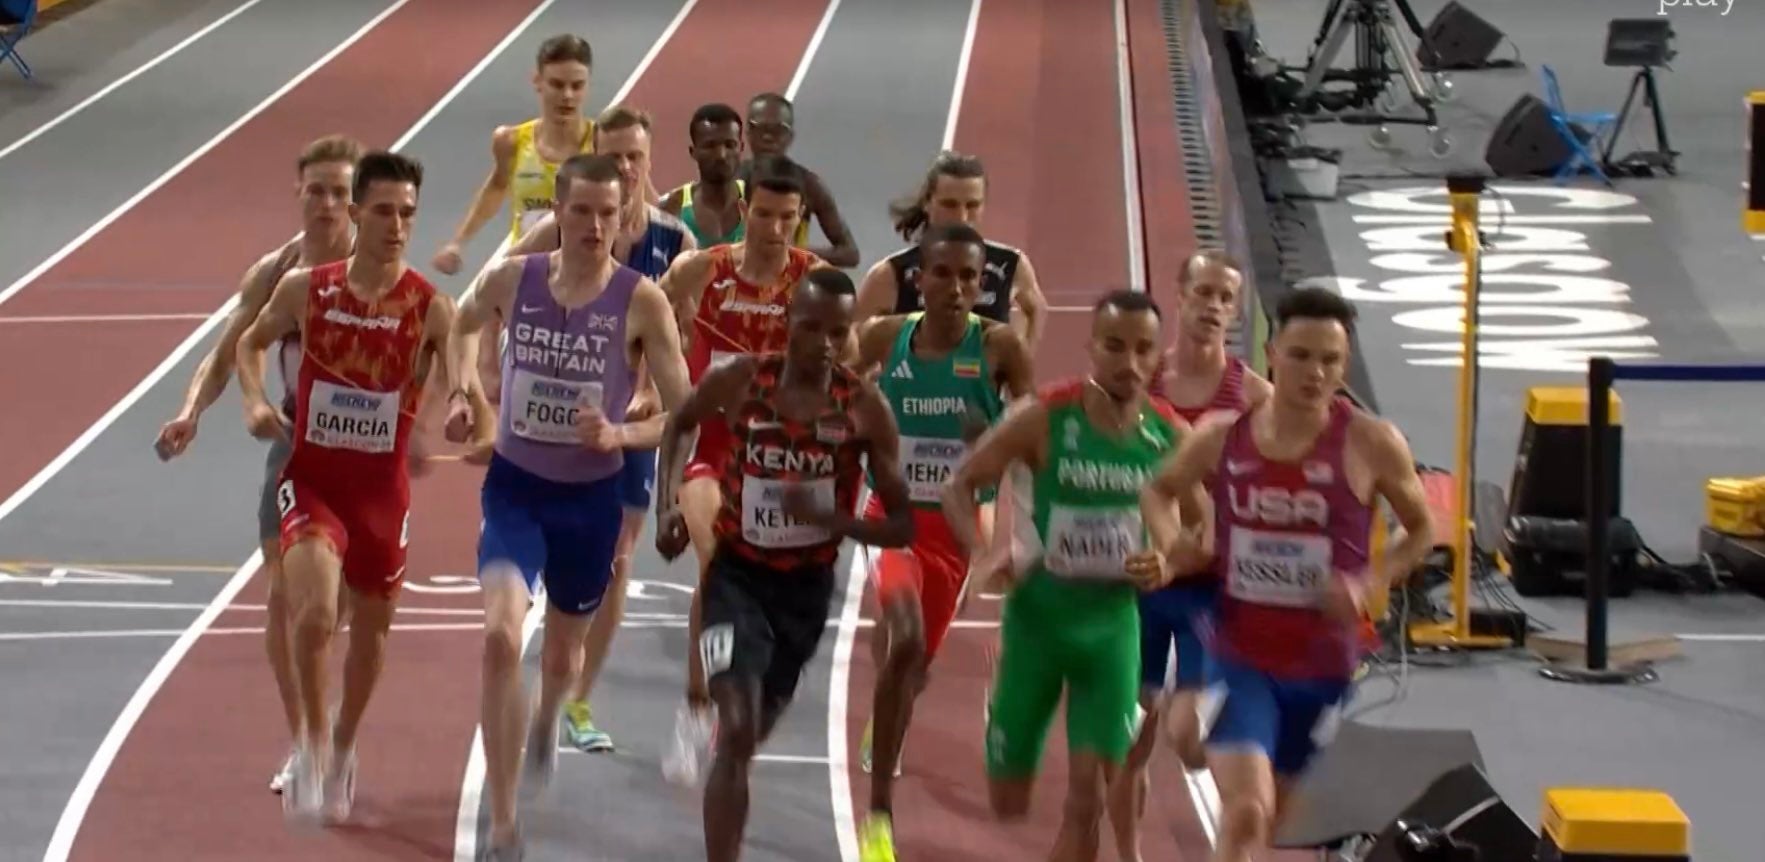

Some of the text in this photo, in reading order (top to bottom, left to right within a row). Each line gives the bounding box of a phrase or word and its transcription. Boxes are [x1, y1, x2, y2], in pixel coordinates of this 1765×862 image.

[515, 321, 609, 353] GREAT
[515, 343, 606, 374] BRITAIN
[903, 396, 968, 416] ETHIOPIA
[316, 411, 390, 437] GARCÍA
[746, 443, 835, 475] KENYA
[1228, 482, 1329, 528] USA
